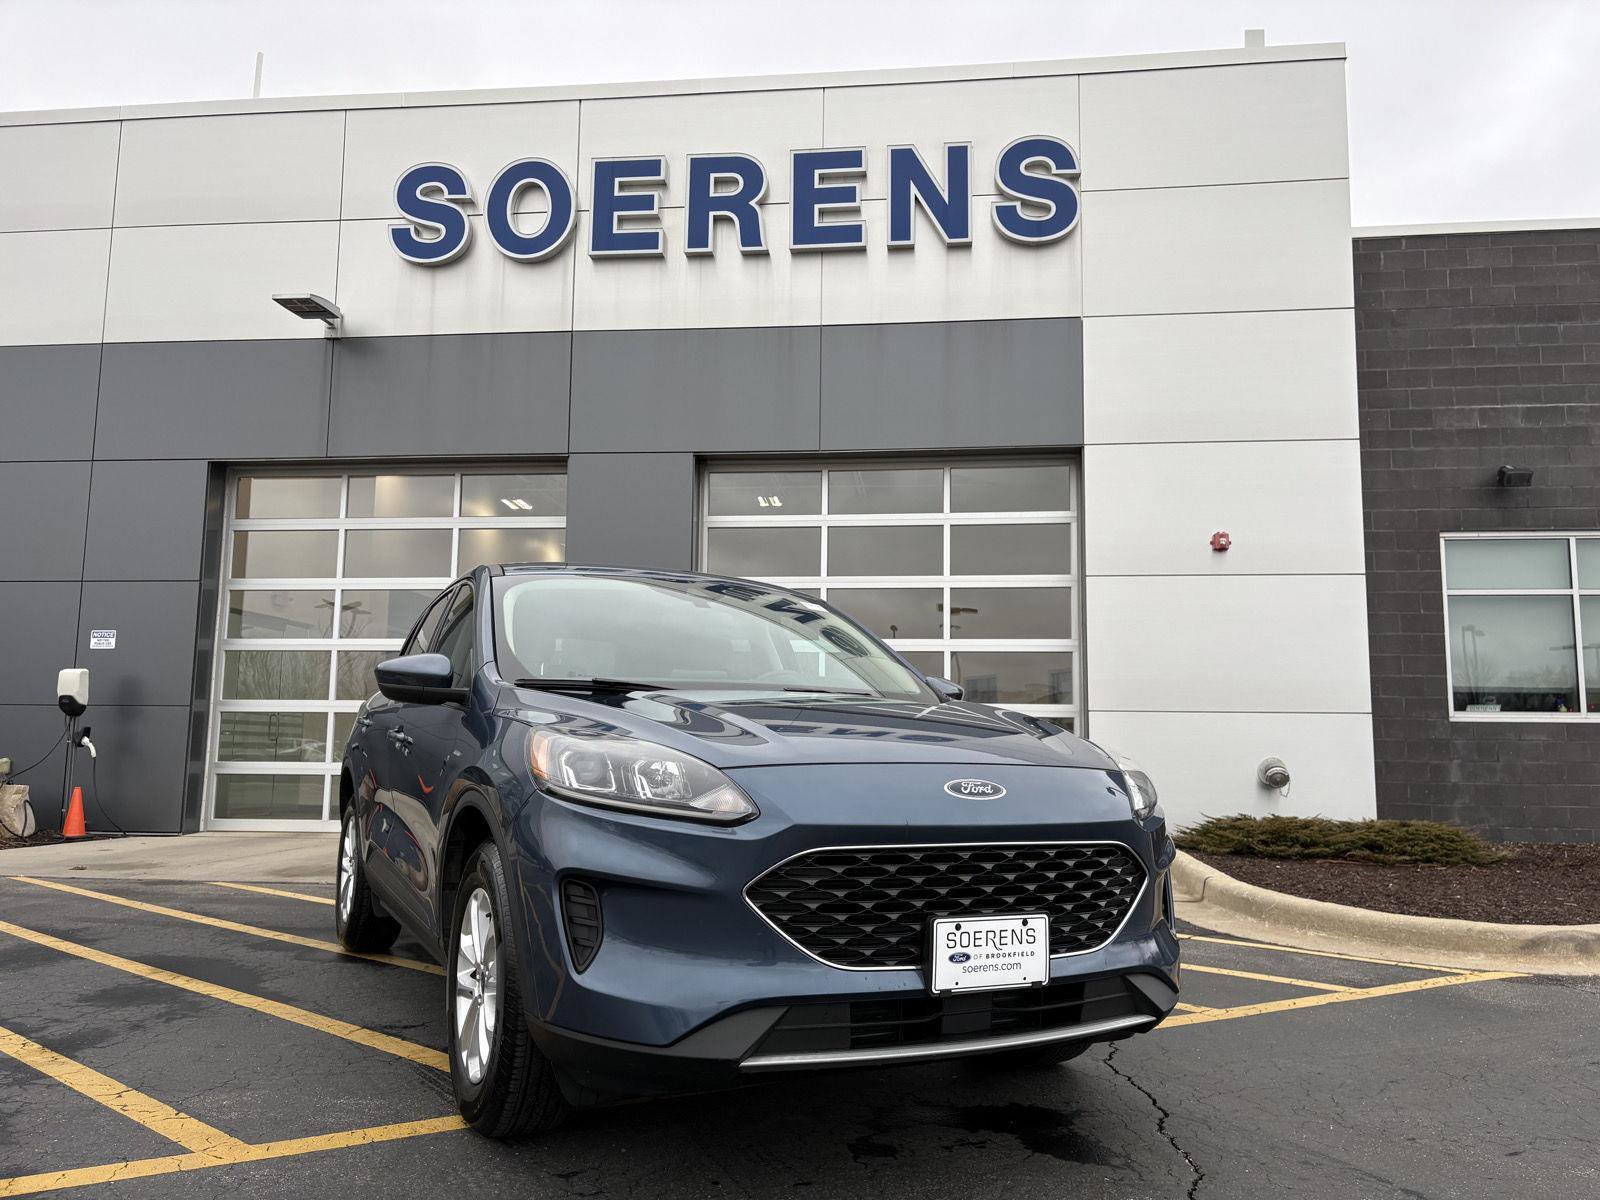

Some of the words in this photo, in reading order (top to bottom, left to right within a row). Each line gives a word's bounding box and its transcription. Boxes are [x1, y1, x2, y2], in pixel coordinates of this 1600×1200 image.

[388, 134, 1082, 266] SOERENS
[961, 781, 994, 794] Ford
[946, 928, 1036, 951] SOERENS
[985, 951, 1035, 960] BROOKFIELD
[962, 962, 1022, 974] soerens.com
